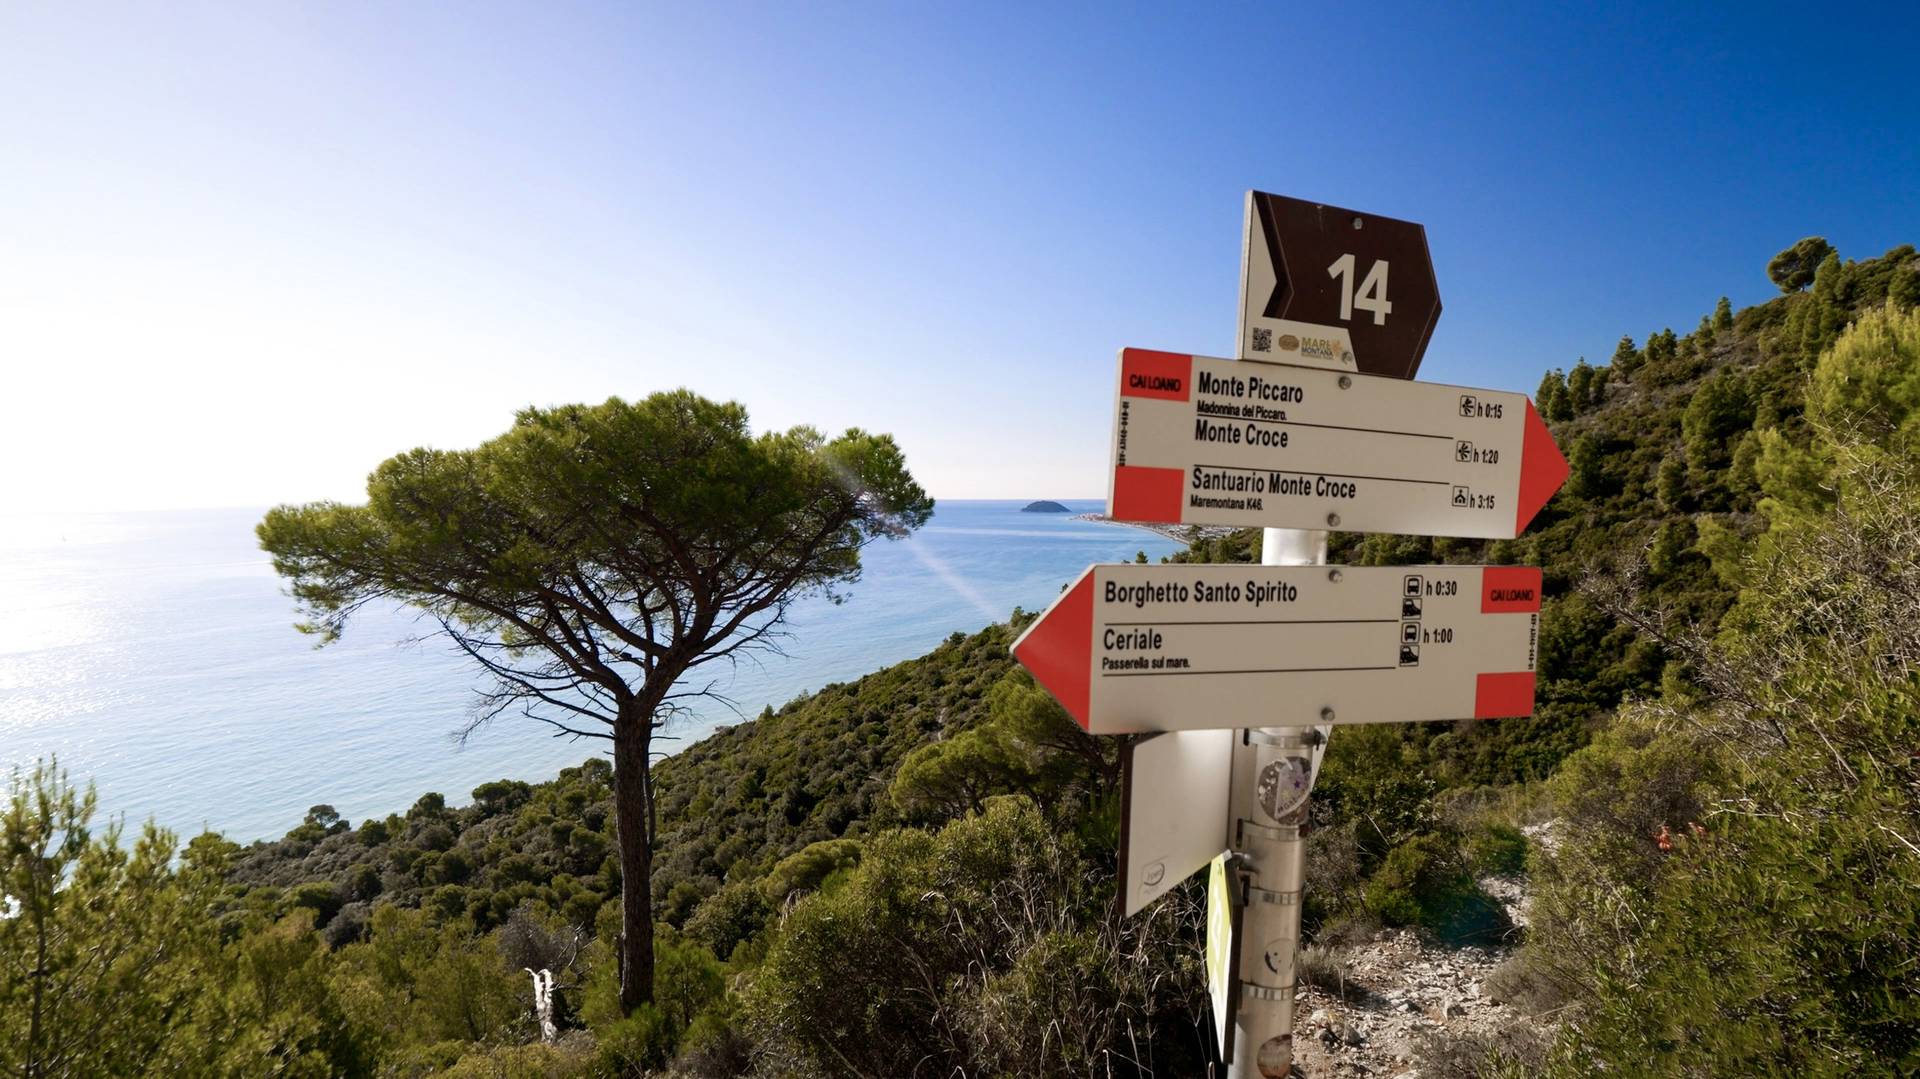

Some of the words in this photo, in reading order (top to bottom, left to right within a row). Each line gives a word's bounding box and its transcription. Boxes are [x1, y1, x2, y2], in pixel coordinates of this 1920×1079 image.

[1327, 253, 1392, 326] 14
[1129, 374, 1147, 389] CAI
[1148, 376, 1182, 392] LOANO
[1198, 371, 1244, 397] Monte
[1248, 377, 1303, 403] Piccaro
[1197, 400, 1240, 416] Madonnina
[1242, 404, 1255, 417] del
[1255, 405, 1287, 420] Piccaro.
[1477, 402, 1483, 417] h
[1485, 403, 1502, 419] 0:15
[1195, 419, 1241, 444] Monte
[1246, 423, 1288, 448] Croce
[1473, 448, 1479, 463] h
[1482, 448, 1499, 464] 1:20
[1192, 467, 1264, 493] Santuario
[1268, 472, 1311, 496] Monte
[1316, 476, 1356, 498] Croce
[1190, 494, 1245, 510] Maremontana
[1469, 494, 1475, 508] h
[1478, 494, 1495, 509] 3:15
[1105, 580, 1189, 608] Borghetto
[1194, 580, 1240, 602] Santo
[1245, 581, 1297, 607] Spirito
[1426, 580, 1432, 596] h
[1435, 581, 1457, 596] 0:30
[1491, 589, 1504, 601] CAI
[1506, 589, 1534, 601] LOANO
[1103, 628, 1162, 650] Ceriale
[1423, 628, 1429, 643] h
[1433, 628, 1453, 643] 1:00
[1102, 656, 1149, 670] Passerella
[1151, 656, 1164, 669] sul
[1166, 658, 1190, 668] mare.
